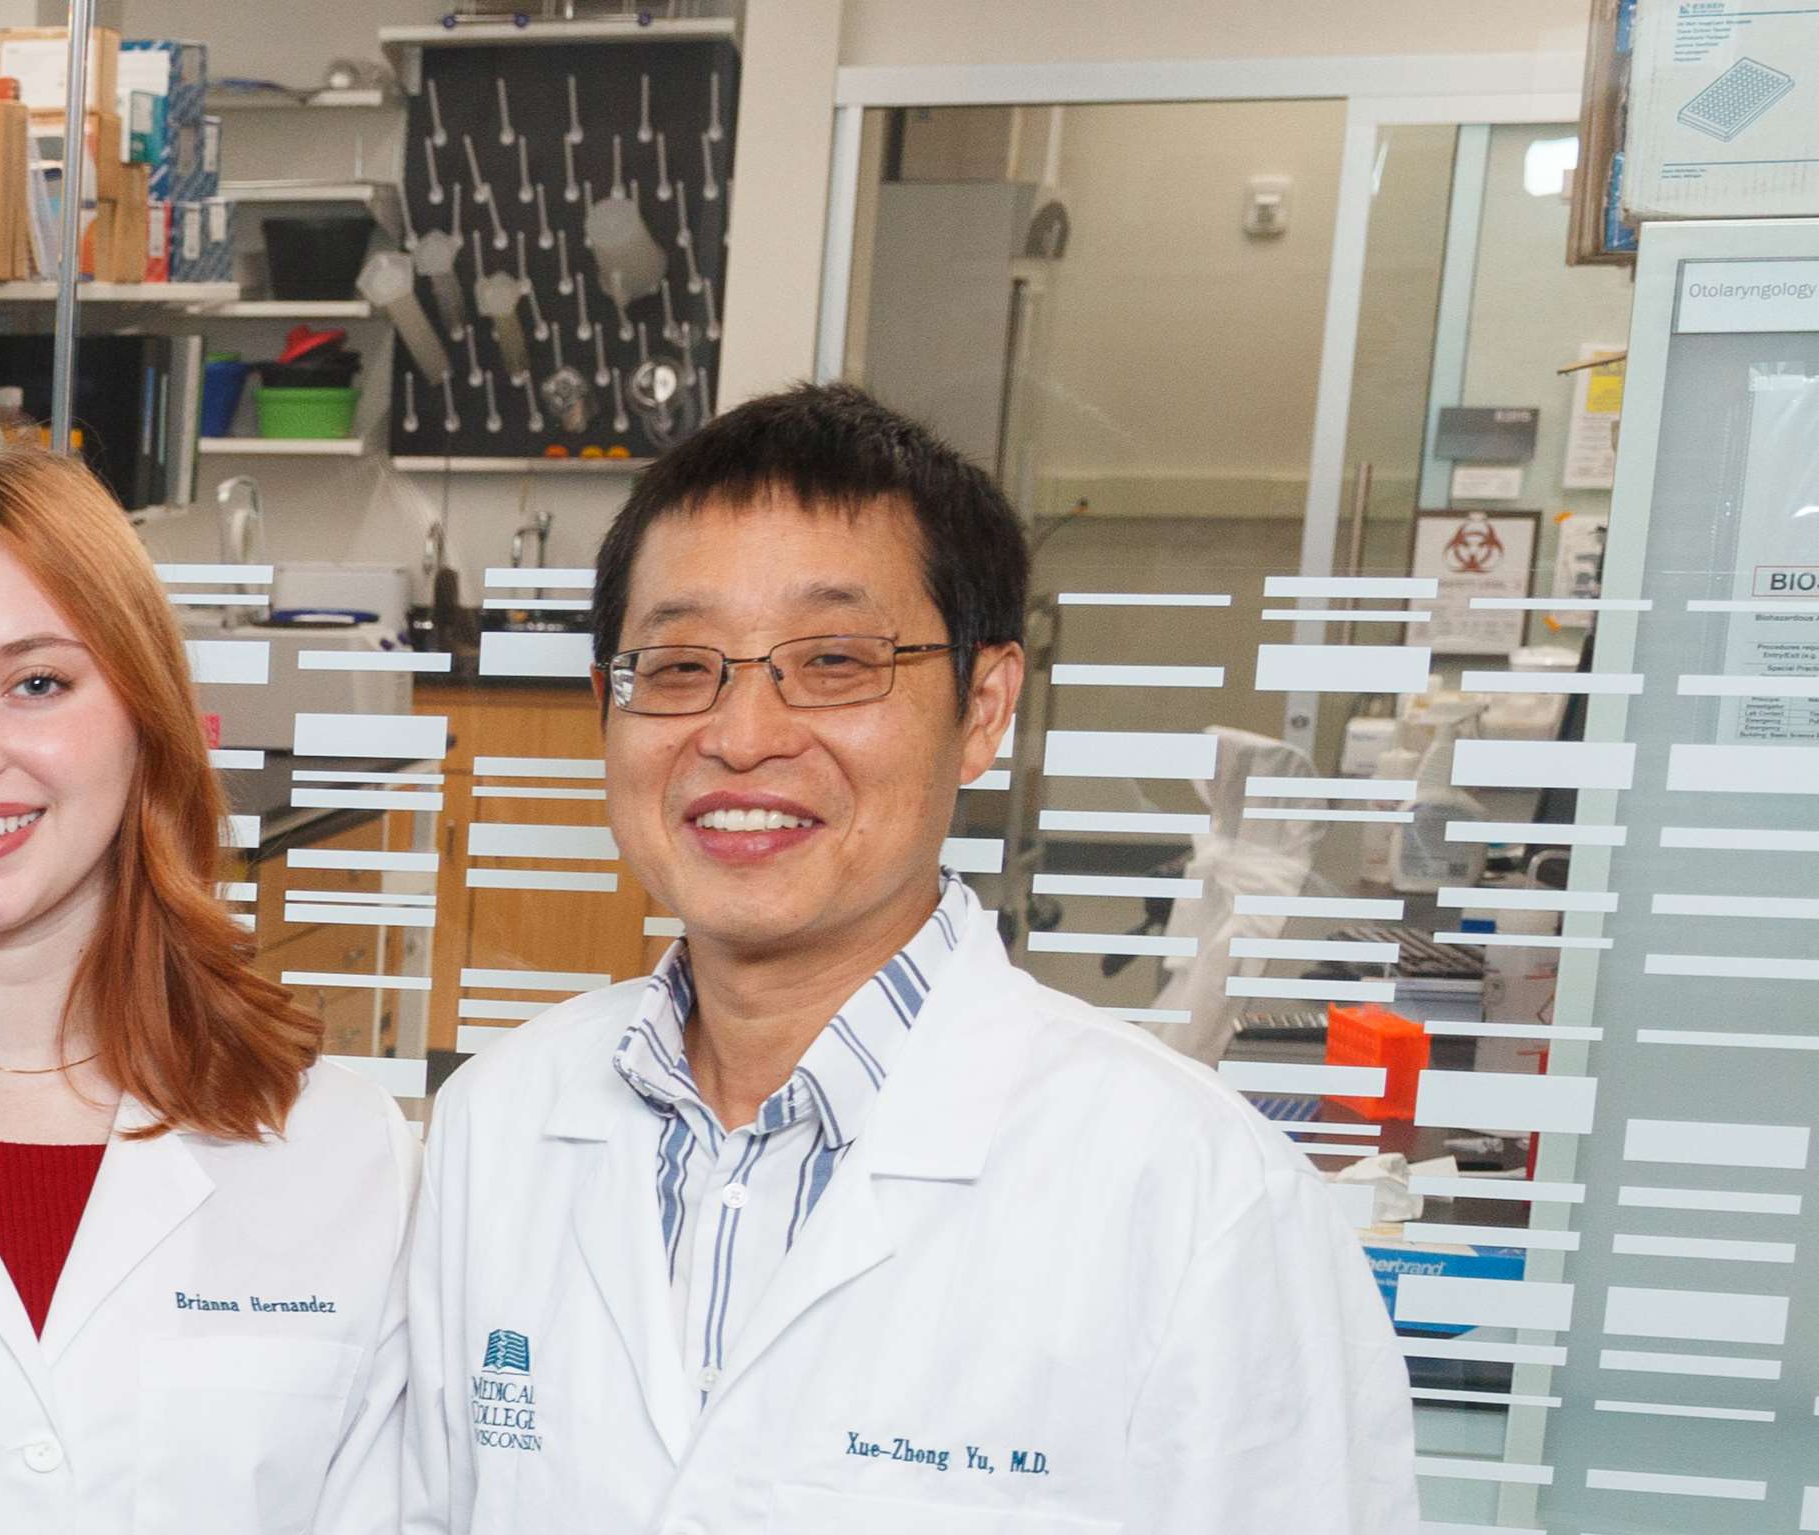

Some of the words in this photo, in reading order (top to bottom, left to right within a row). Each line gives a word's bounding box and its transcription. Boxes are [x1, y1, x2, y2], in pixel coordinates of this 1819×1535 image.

[1688, 282, 1818, 300] Otolaryngology
[1770, 572, 1819, 591] BIO
[175, 1291, 240, 1312] Brianna
[250, 1295, 337, 1314] Hernandez
[471, 1376, 536, 1405] MEDICAL
[846, 1431, 950, 1471] Xue-Zhong
[966, 1446, 994, 1474] Yu,
[1010, 1450, 1050, 1475] M.D.
